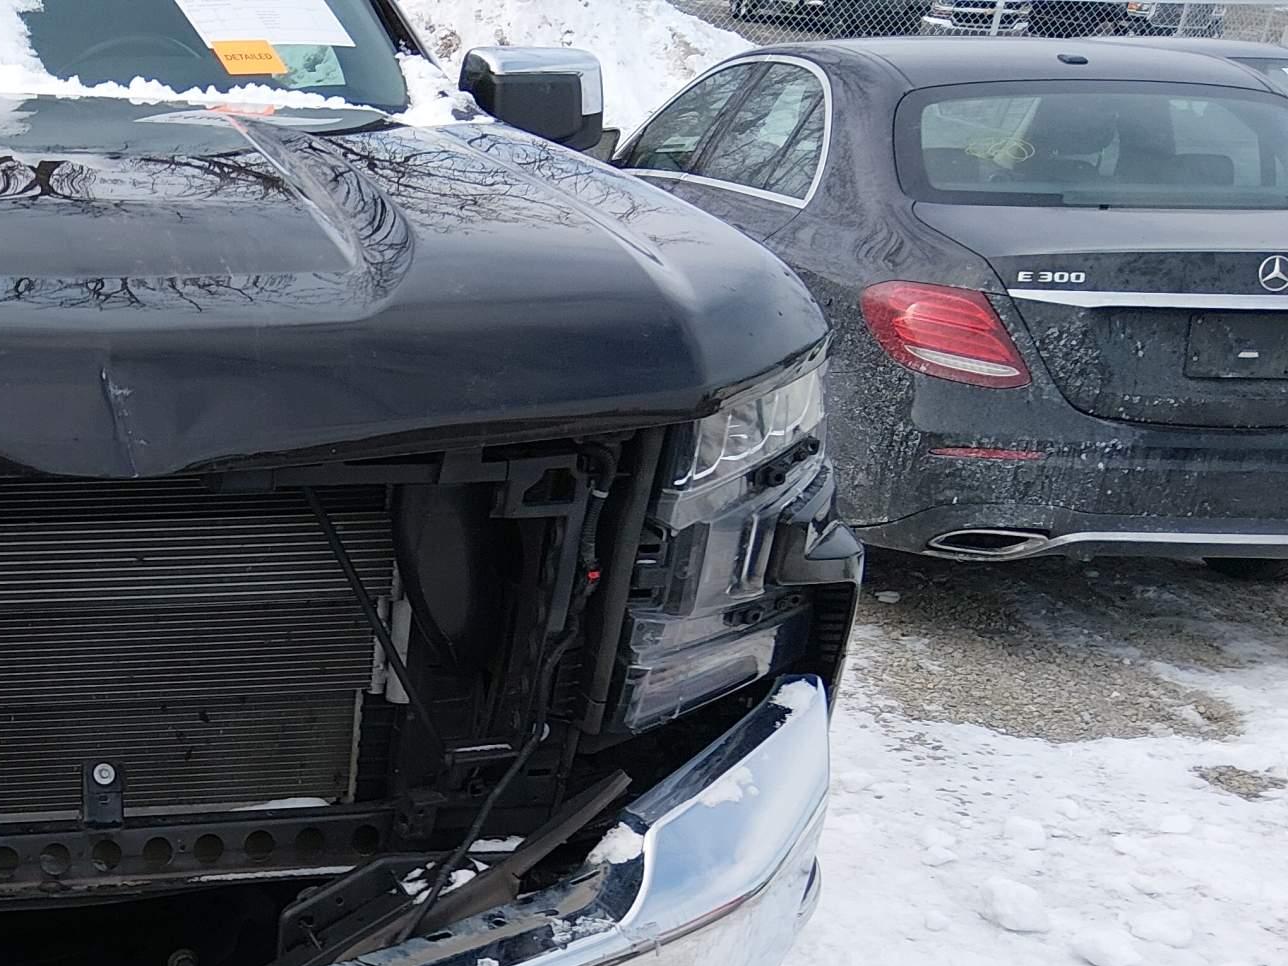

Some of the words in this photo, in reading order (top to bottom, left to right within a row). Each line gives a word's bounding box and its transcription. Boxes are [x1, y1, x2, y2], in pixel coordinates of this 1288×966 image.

[223, 52, 273, 62] DETAILED
[1017, 271, 1034, 283] E
[1038, 271, 1086, 284] 300
